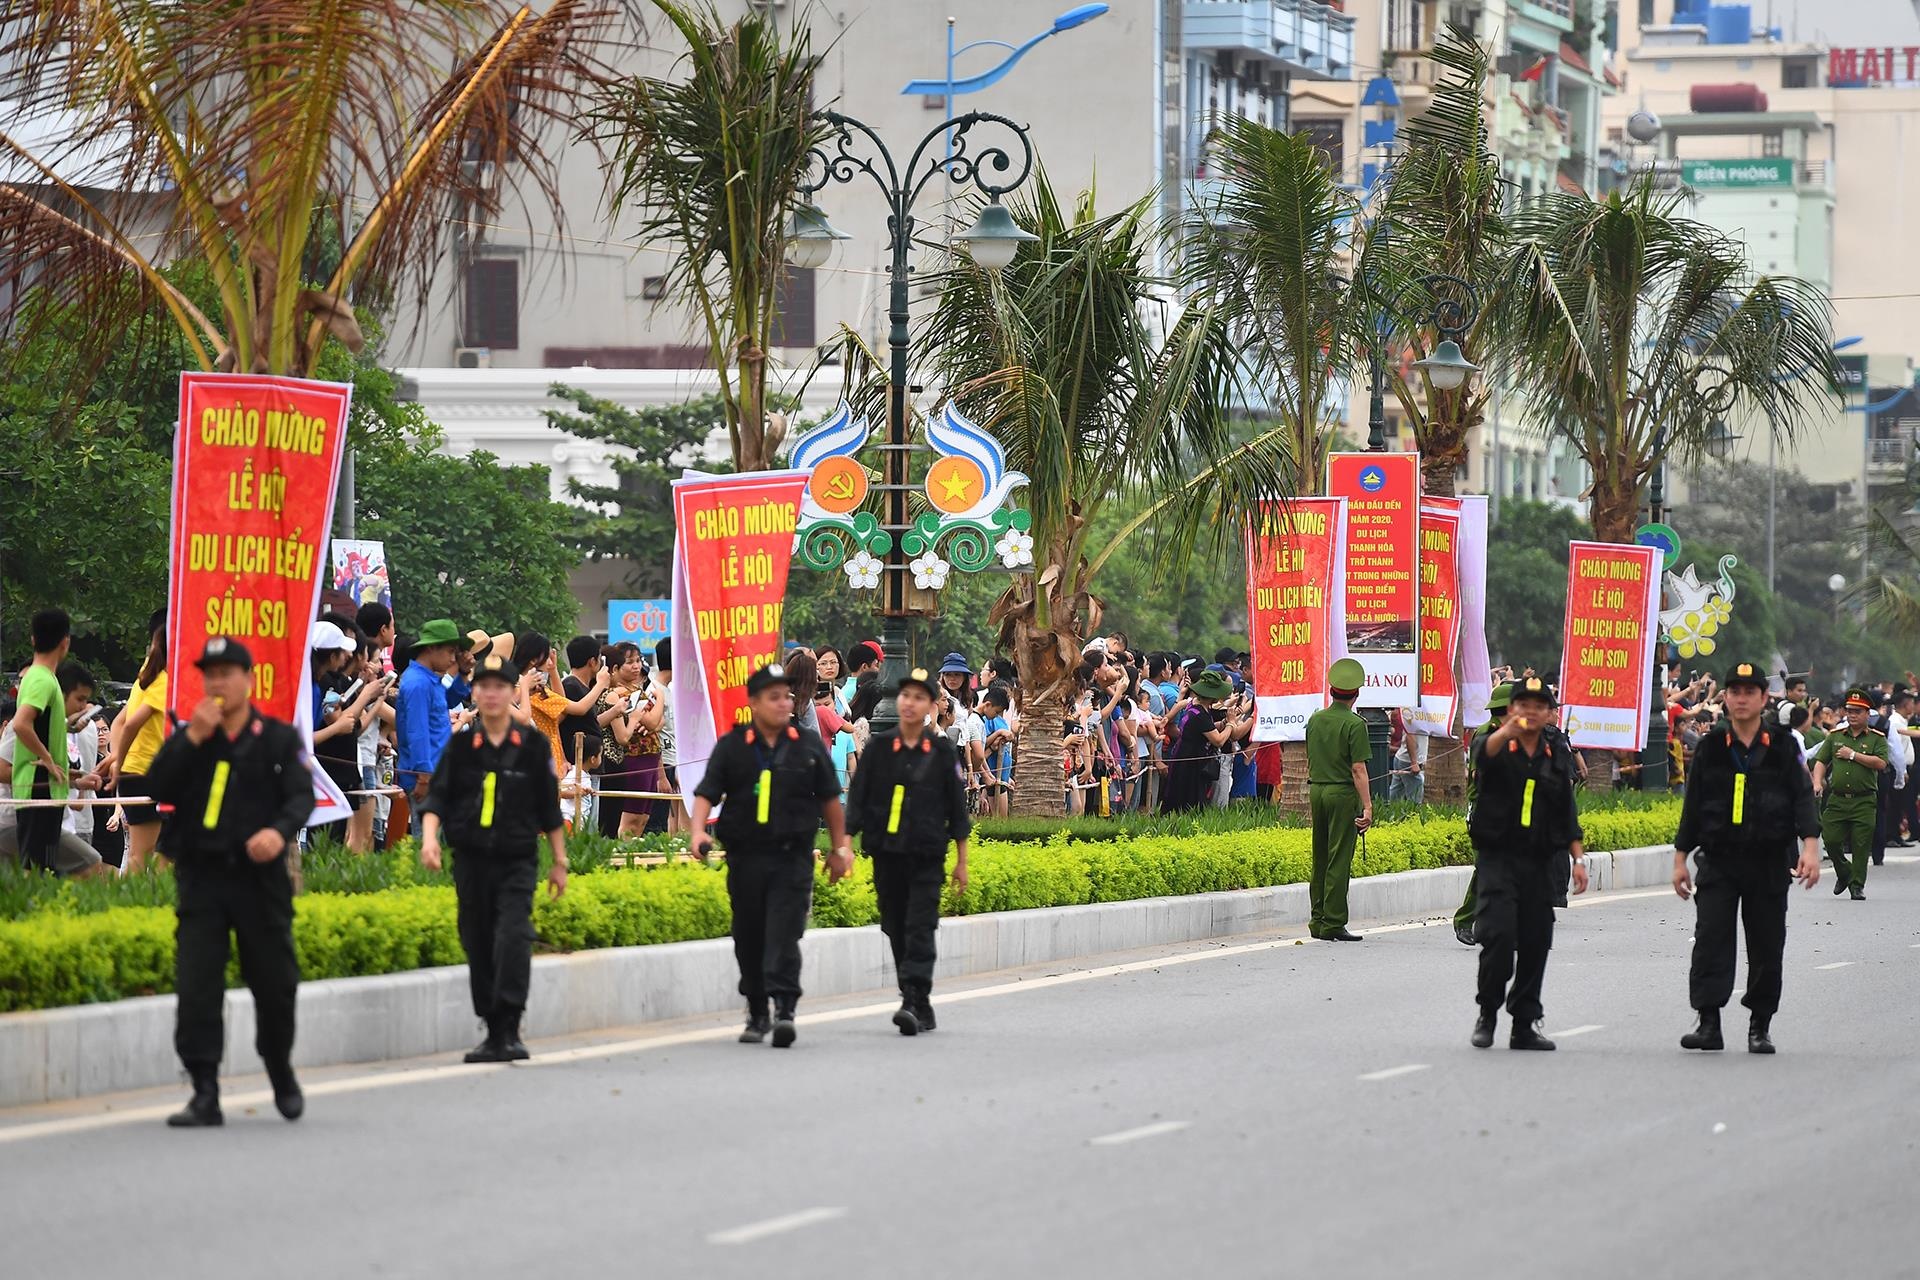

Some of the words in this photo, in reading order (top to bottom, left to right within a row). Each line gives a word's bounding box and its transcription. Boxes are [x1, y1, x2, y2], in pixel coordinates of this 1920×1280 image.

[1828, 47, 1893, 82] MAI
[201, 401, 260, 447] CHÀO
[264, 403, 327, 456] MỪNG
[228, 456, 254, 510] LỄ
[258, 466, 287, 520] HỘI
[1348, 499, 1365, 510] HẤN
[1366, 499, 1383, 510] ĐẤU
[1385, 499, 1401, 510] ĐẾN
[695, 501, 739, 541] CHÀO
[744, 496, 796, 535] MỪNG
[1350, 514, 1370, 524] NĂM
[1349, 543, 1376, 552] THANH
[1377, 542, 1394, 552] HÓA
[1356, 529, 1368, 538] DU
[1369, 529, 1388, 540] LỊCH
[1425, 526, 1450, 553] MỪNG
[189, 533, 219, 571] DU
[223, 535, 270, 581] LỊCH
[721, 544, 739, 588] LỄ
[744, 547, 772, 592] HỘI
[1276, 541, 1289, 573] LỄ
[1349, 555, 1366, 566] TRỞ
[1367, 556, 1394, 566] THÀNH
[1580, 556, 1608, 578] CHÀO
[1610, 557, 1641, 581] MỪNG
[1353, 571, 1380, 580] TRONG
[1381, 570, 1410, 580] NHỮNG
[1423, 559, 1438, 588] HỘI
[1257, 587, 1274, 610] DU
[1277, 586, 1299, 614] LỊCH
[1347, 585, 1374, 596] TRỌNG
[1375, 582, 1396, 594] ĐIỂM
[1592, 583, 1605, 608] LỄ
[1607, 587, 1625, 613] HỘI
[206, 584, 253, 636] SẦM
[622, 602, 667, 632] GỬI
[1356, 599, 1367, 608] DU
[1369, 599, 1387, 610] LỊCH
[1361, 611, 1373, 622] CẢ
[698, 610, 721, 640] DU
[724, 604, 759, 643] LỊCH
[763, 596, 784, 633] BI
[1270, 616, 1293, 647] SẦM
[1573, 617, 1588, 637] DU
[1590, 618, 1613, 641] LỊCH
[1615, 614, 1640, 640] BIỂN
[716, 648, 749, 690] SẦM
[1580, 642, 1605, 667] SẦM
[1607, 649, 1629, 669] SƠN
[1281, 659, 1304, 683] 2019
[1363, 672, 1381, 687] HÀ
[1384, 673, 1408, 688] NỘI
[1422, 663, 1433, 684] 19
[1589, 677, 1616, 698] 2019
[1260, 714, 1305, 725] BAMBOO
[1584, 721, 1602, 733] SUN
[1604, 723, 1633, 734] GROUP
